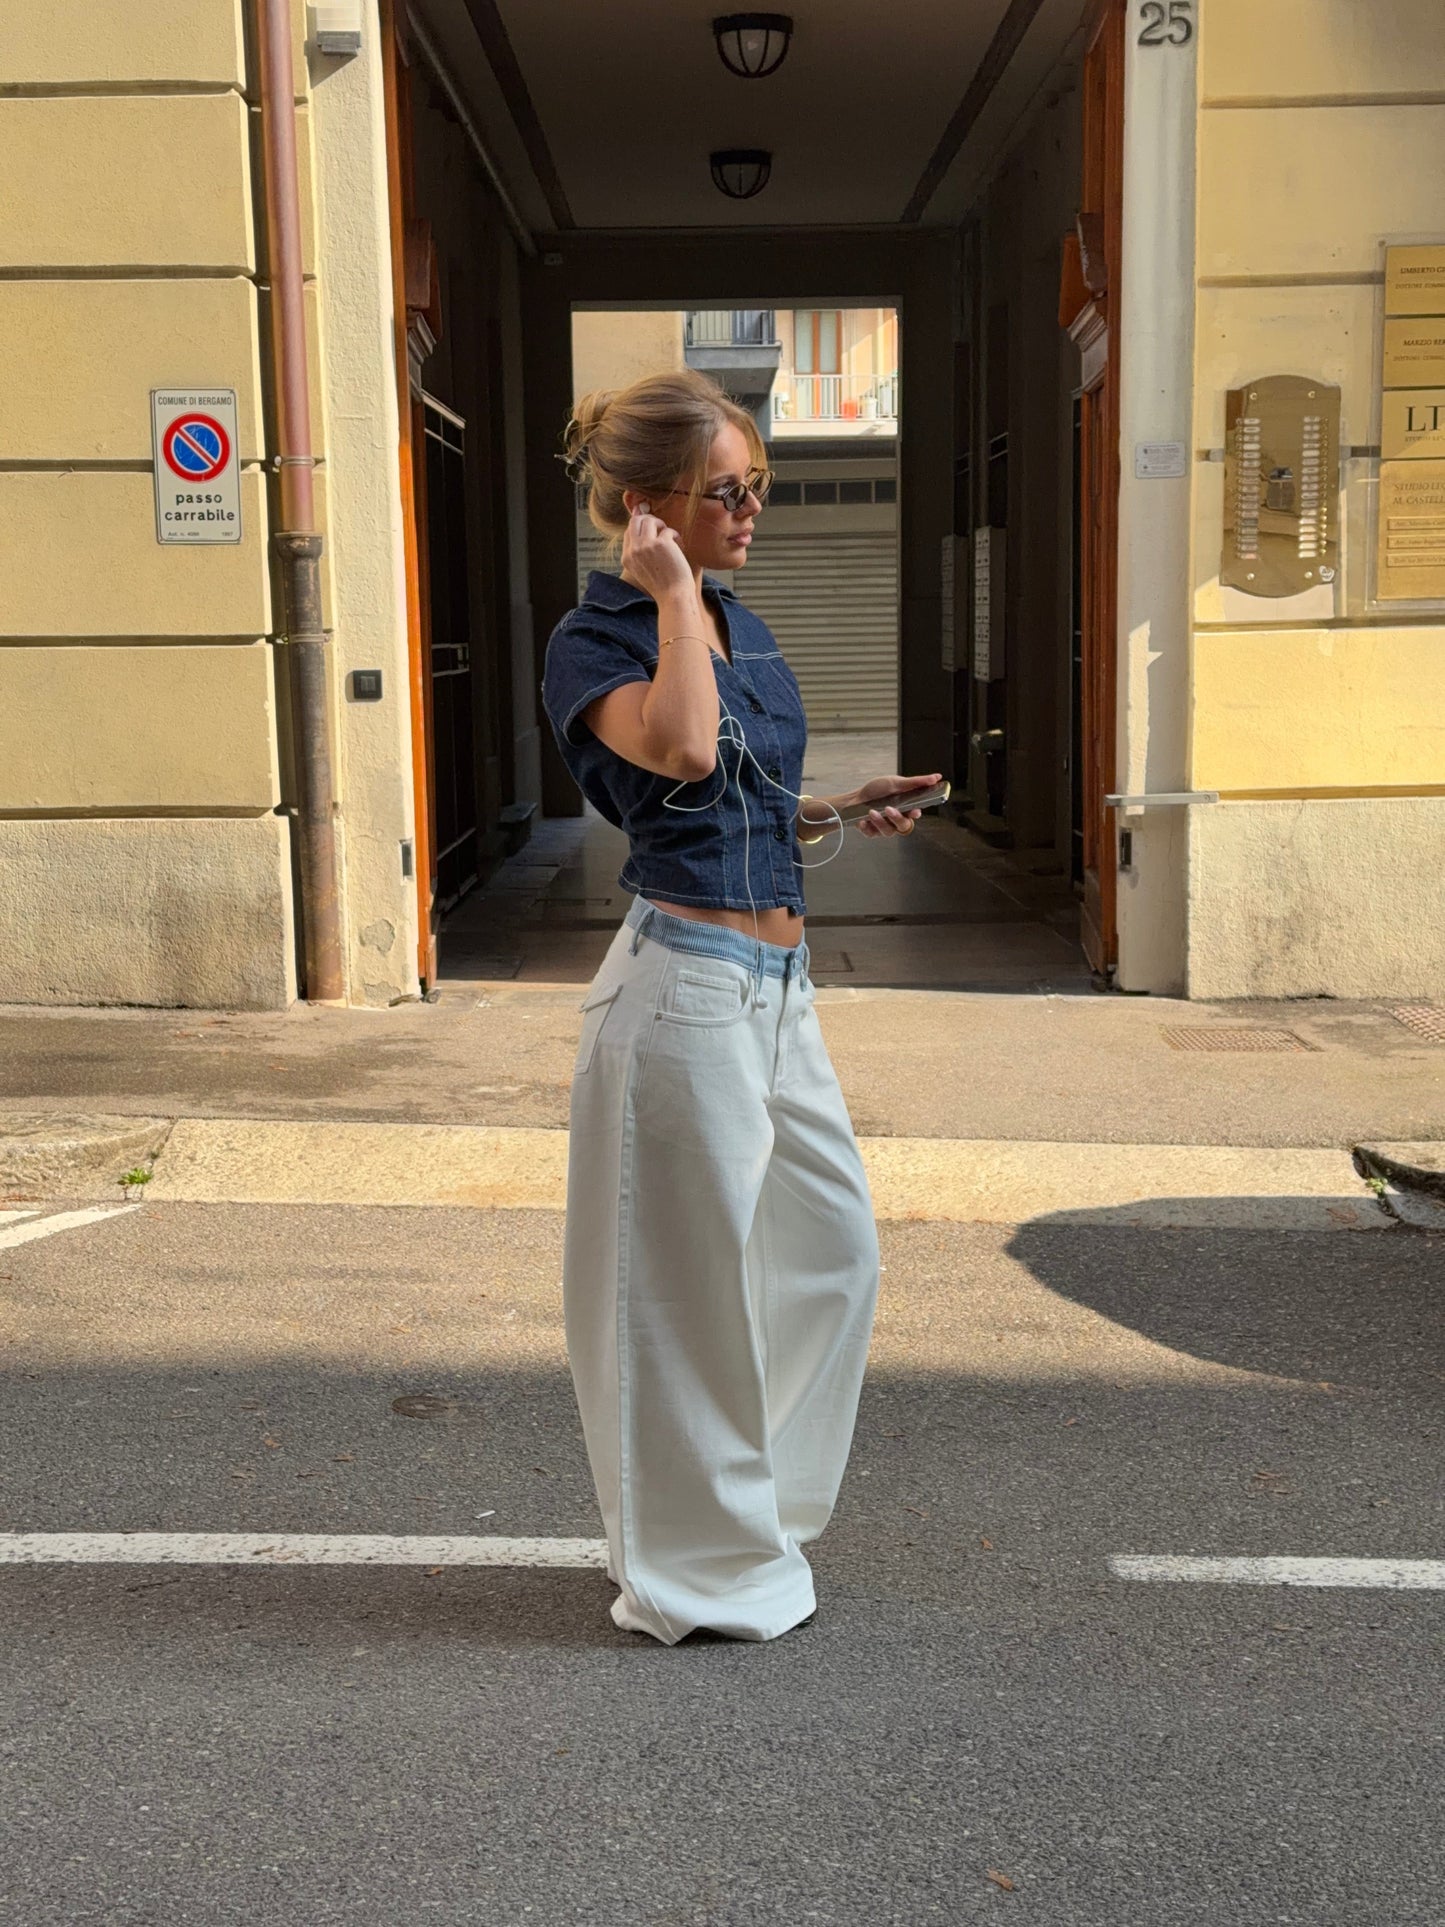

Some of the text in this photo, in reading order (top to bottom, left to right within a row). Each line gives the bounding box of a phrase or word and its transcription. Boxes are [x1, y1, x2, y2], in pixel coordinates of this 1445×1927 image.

[1138, 1, 1192, 46] 25
[158, 396, 232, 405] COMUNE DI BERGAMO
[1394, 482, 1430, 491] STUDIO
[175, 494, 222, 506] passo
[165, 509, 235, 521] carrabile
